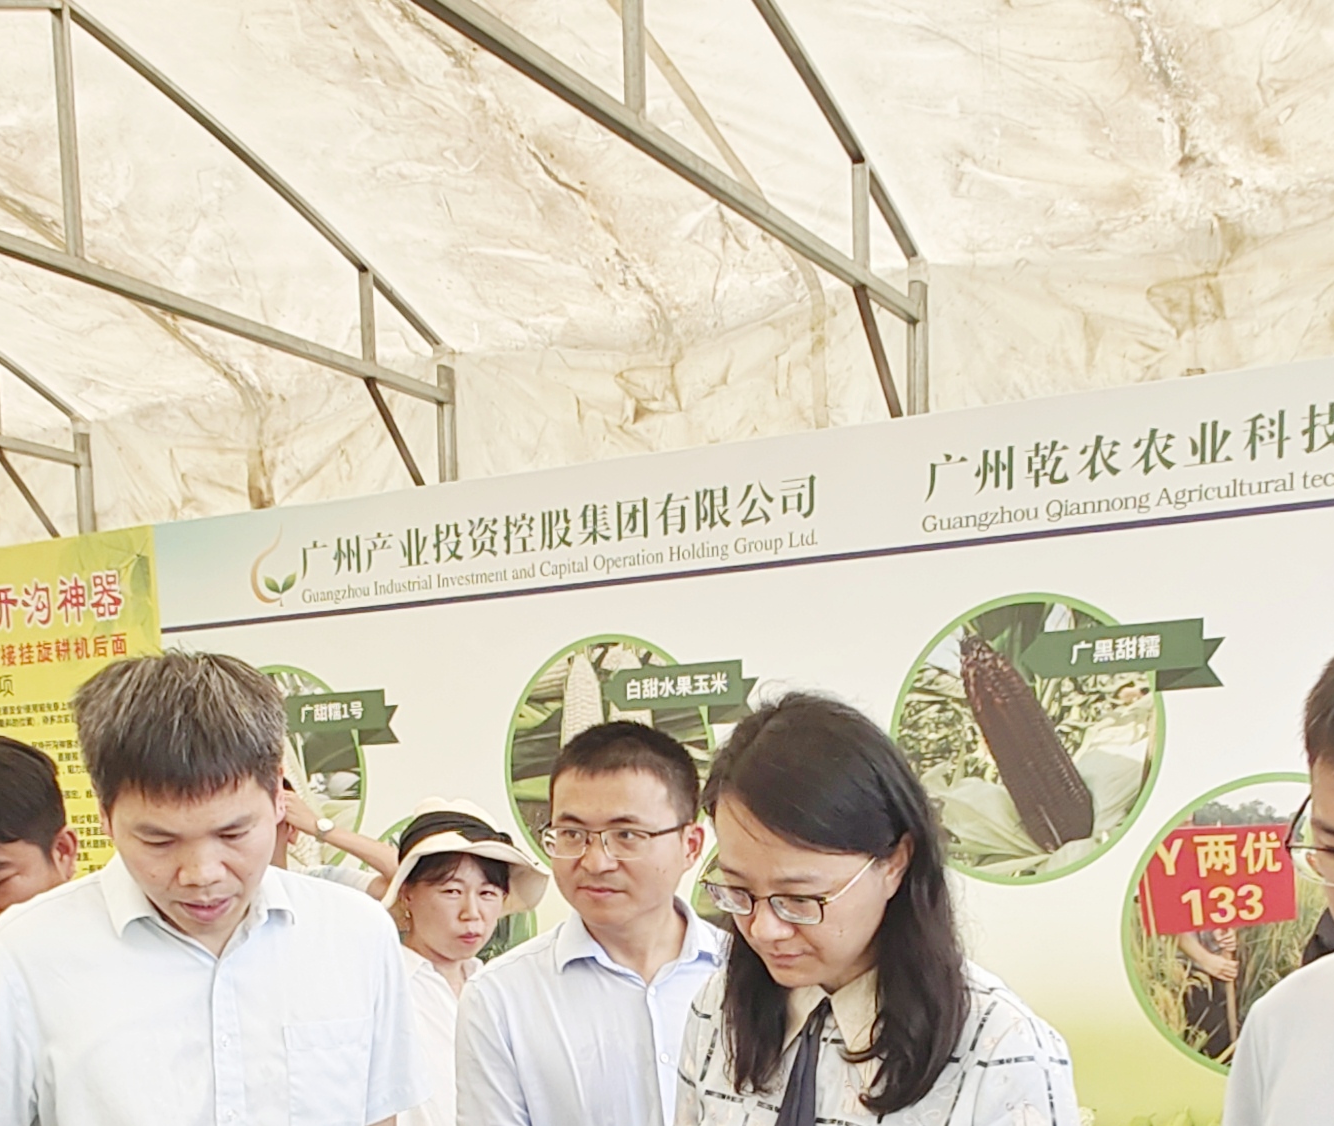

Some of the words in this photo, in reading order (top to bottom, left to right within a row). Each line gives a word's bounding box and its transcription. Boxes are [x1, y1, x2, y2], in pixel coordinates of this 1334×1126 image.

[921, 503, 1039, 533] Guangzhou
[1045, 492, 1150, 523] Qiannong
[1155, 471, 1295, 510] Agricultural
[300, 473, 817, 582] 广州产业投资控股集团有限公司
[301, 583, 370, 605] Guangzhou
[373, 574, 432, 596] Industrial
[436, 569, 508, 590] Investment
[511, 562, 536, 581] and
[539, 554, 589, 579] Capital
[593, 547, 664, 574] Operation
[668, 537, 729, 562] Holding
[733, 534, 784, 556] Group
[787, 527, 818, 549] Ltd.
[1069, 634, 1162, 664] 广黑甜糯
[626, 671, 728, 701] 白甜水果玉米
[300, 700, 364, 723] 广甜糯1号
[1180, 884, 1265, 928] 133
